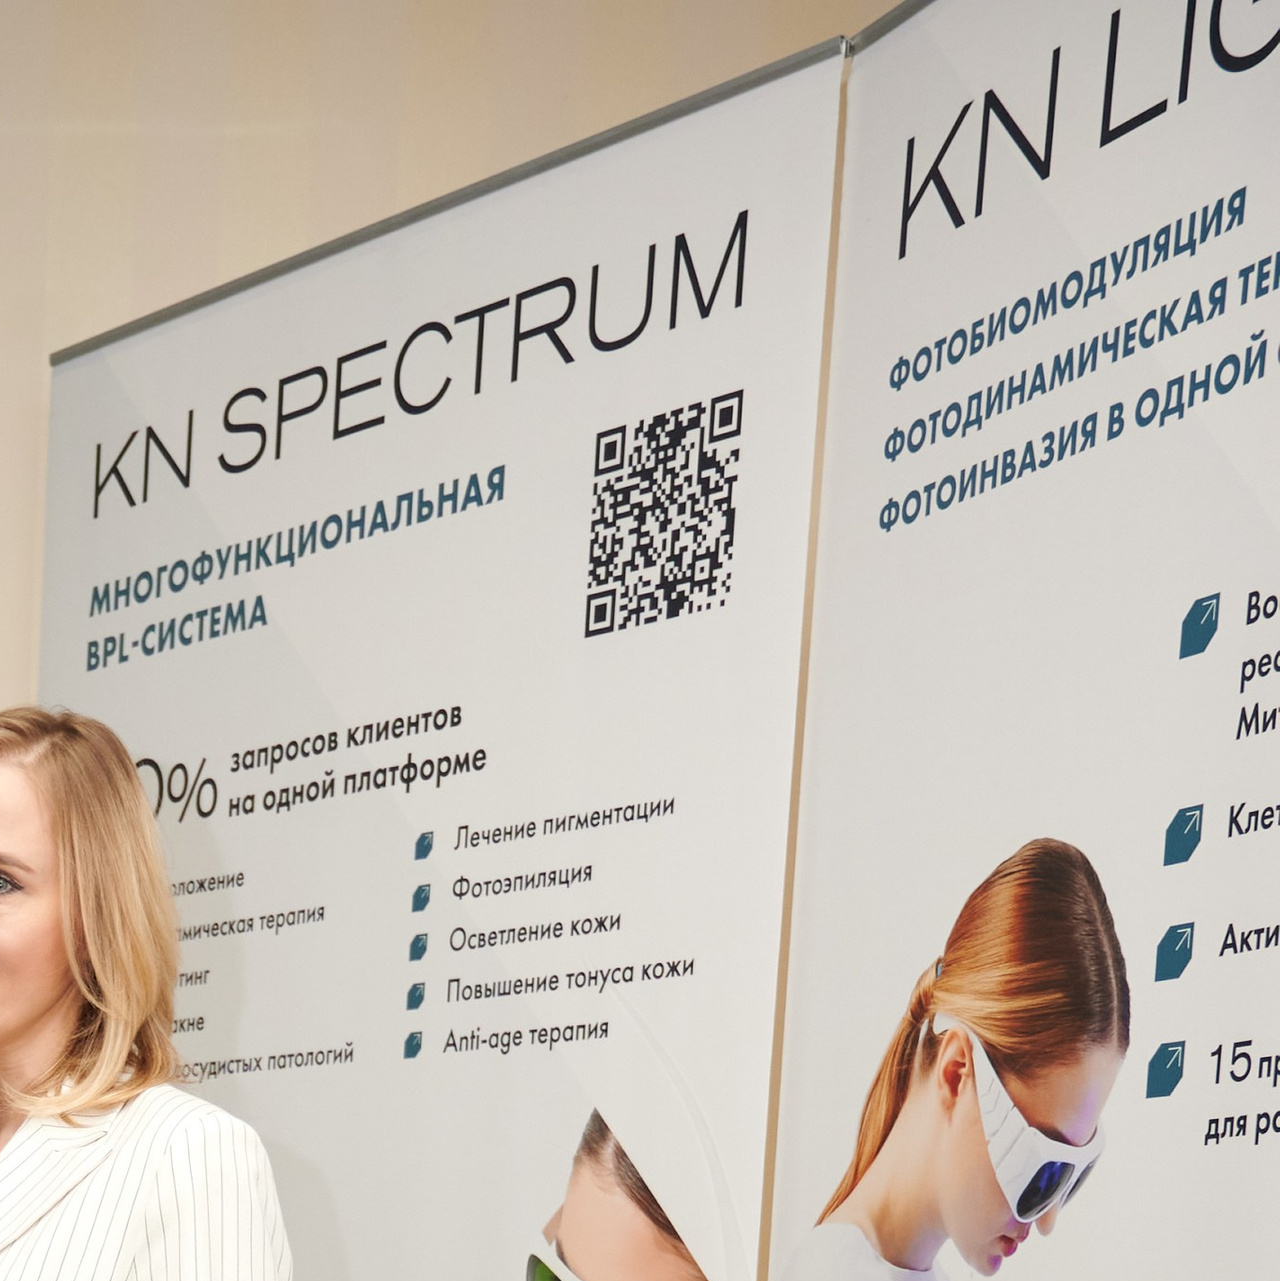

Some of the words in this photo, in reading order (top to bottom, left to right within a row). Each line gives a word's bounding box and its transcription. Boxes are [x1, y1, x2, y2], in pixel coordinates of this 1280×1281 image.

[898, 45, 1061, 261] KN
[889, 186, 1247, 392] ФОТОБИОМОДУЛЯЦИЯ
[92, 408, 194, 520] KN
[218, 208, 749, 475] SPECTRUM
[883, 275, 1228, 463] ФОТОДИНАМИЧЕСКАЯ
[878, 411, 1098, 533] ФОТОИНВАЗИЯ
[1106, 407, 1125, 441] В
[1135, 329, 1268, 428] ОДНОЙ
[89, 465, 507, 618] МНОГОФУНКЦИОНАЛЬНАЯ
[86, 594, 268, 673] BPL-СИСТЕМА
[230, 730, 338, 774] запросов
[346, 705, 463, 748] клиентов
[1236, 702, 1280, 740] Ми
[229, 794, 255, 817] на
[263, 770, 335, 813] одной
[343, 747, 487, 794] платформе
[454, 819, 536, 851] Лечение
[543, 796, 675, 837] пигментации
[452, 864, 593, 901] Фотоэпиляция
[177, 917, 254, 942] мическая
[259, 906, 325, 935] терапия
[449, 920, 564, 953] Осветление
[570, 911, 621, 939] кожи
[446, 970, 560, 1004] Повышение
[565, 962, 634, 994] тонуса
[641, 955, 695, 984] кожи
[268, 1041, 354, 1070] патологий
[443, 1026, 523, 1056] Anti-age
[529, 1018, 610, 1049] терапия
[1210, 1040, 1252, 1084] 15
[1204, 1115, 1247, 1145] для
